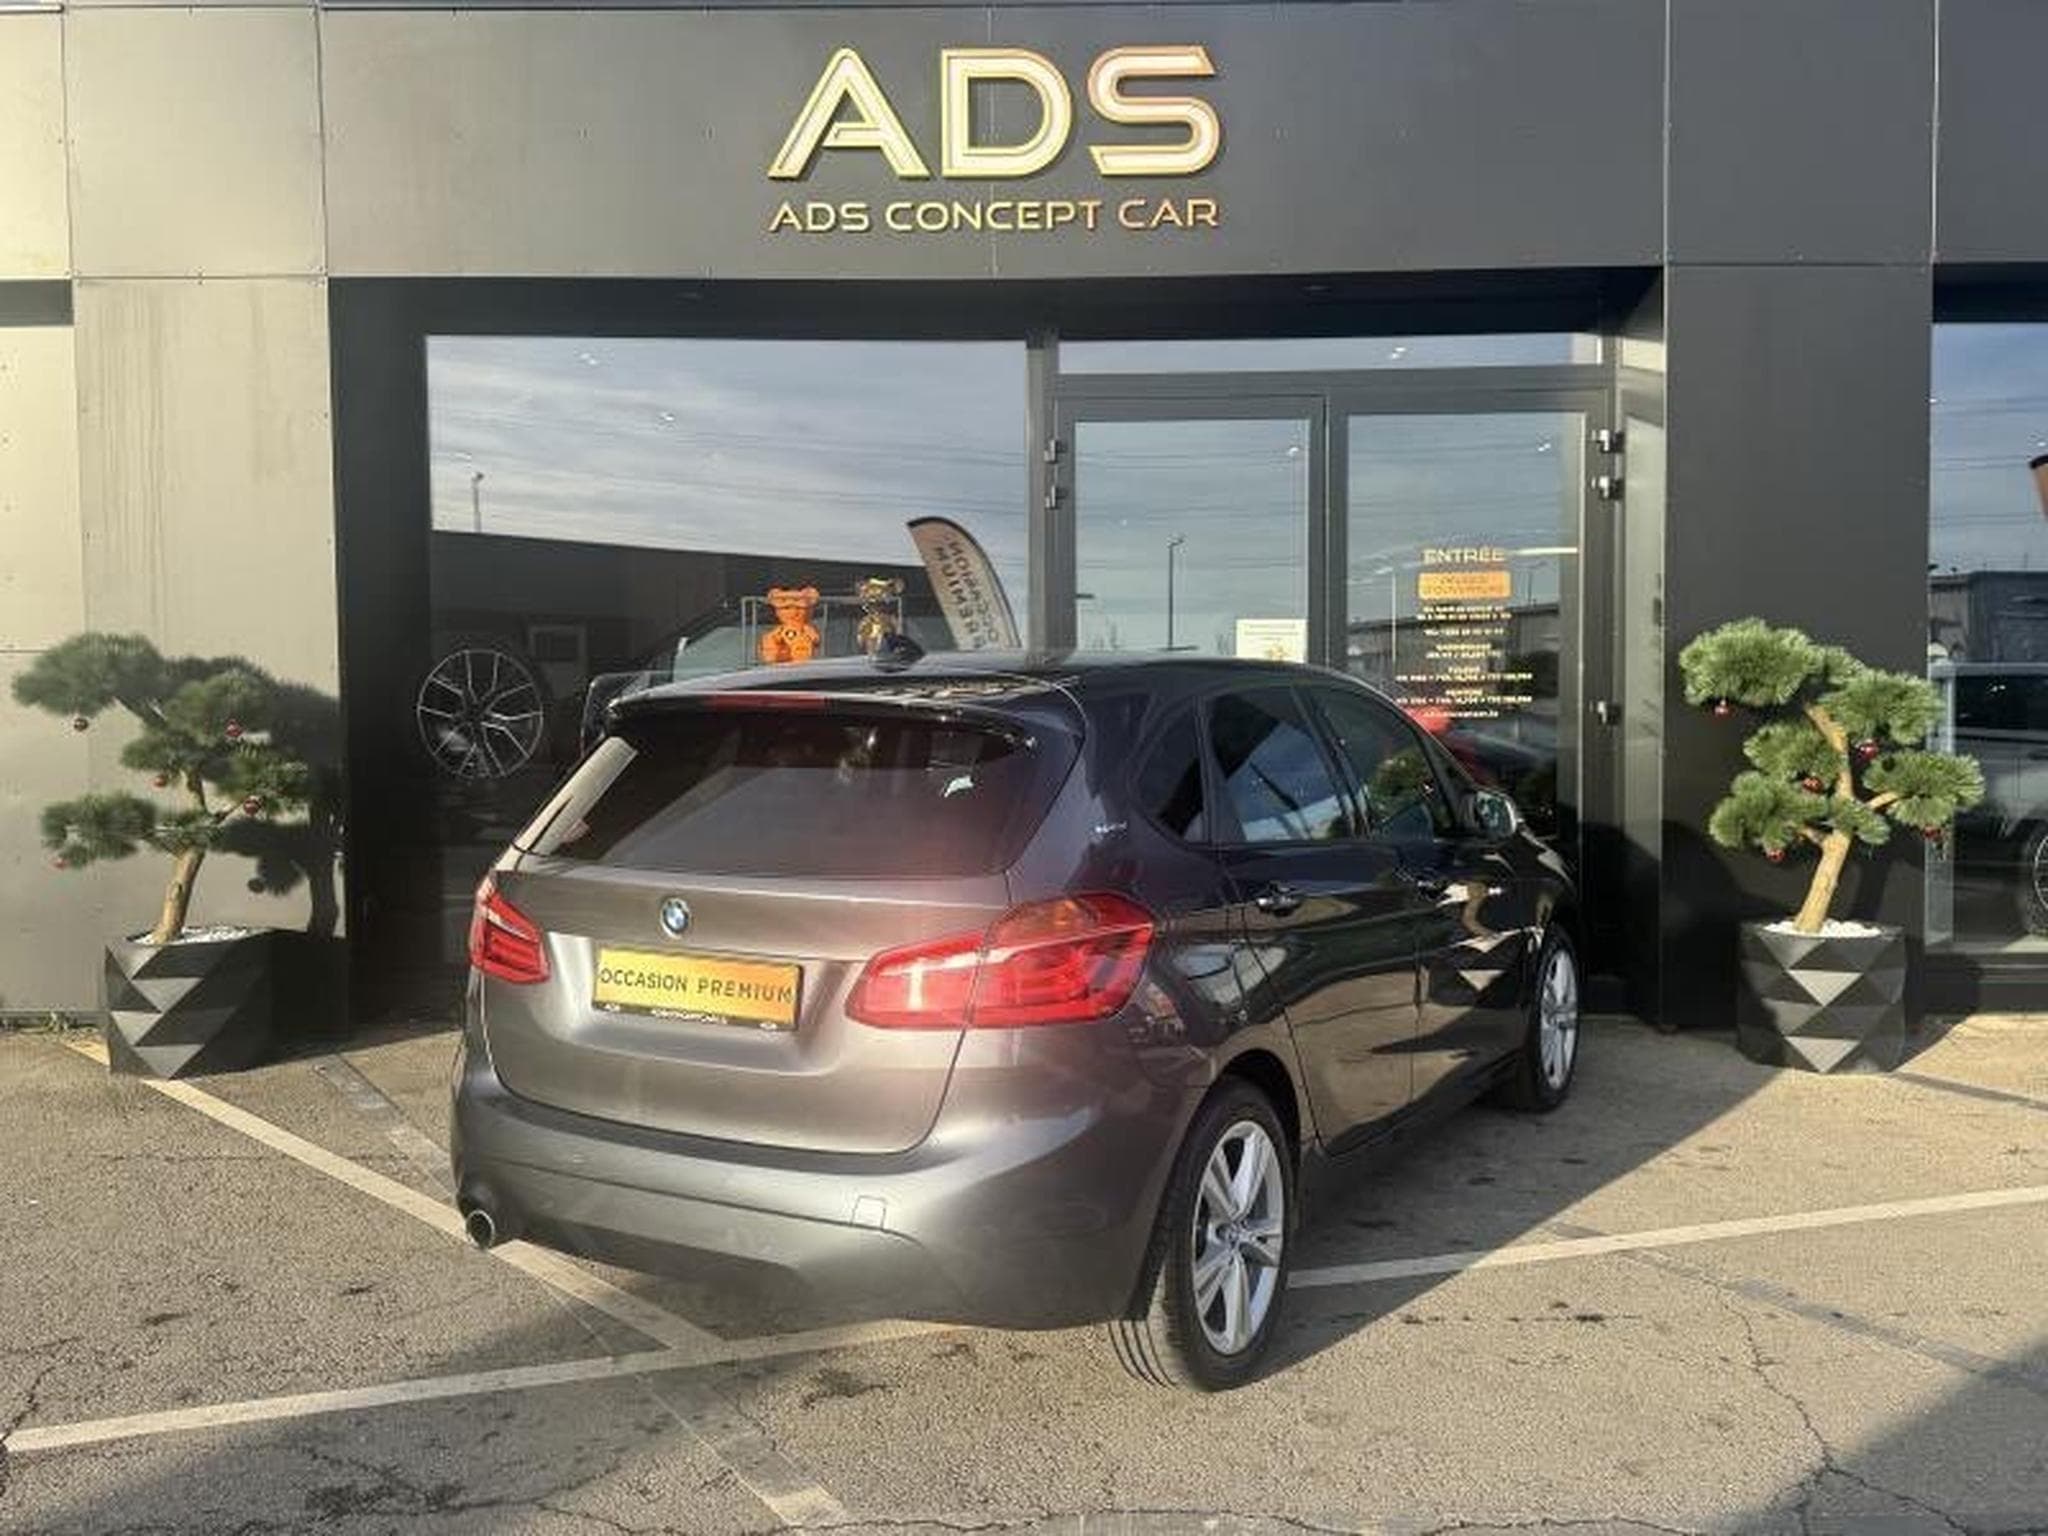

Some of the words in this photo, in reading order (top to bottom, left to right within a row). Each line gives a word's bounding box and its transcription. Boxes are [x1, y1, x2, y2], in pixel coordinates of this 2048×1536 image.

[768, 45, 1220, 178] ADS
[769, 200, 869, 232] ADS
[885, 200, 1104, 231] CONCEPT
[1117, 197, 1220, 229] CAR
[600, 967, 689, 993] OCCASION
[697, 978, 793, 1002] PREMIUM
